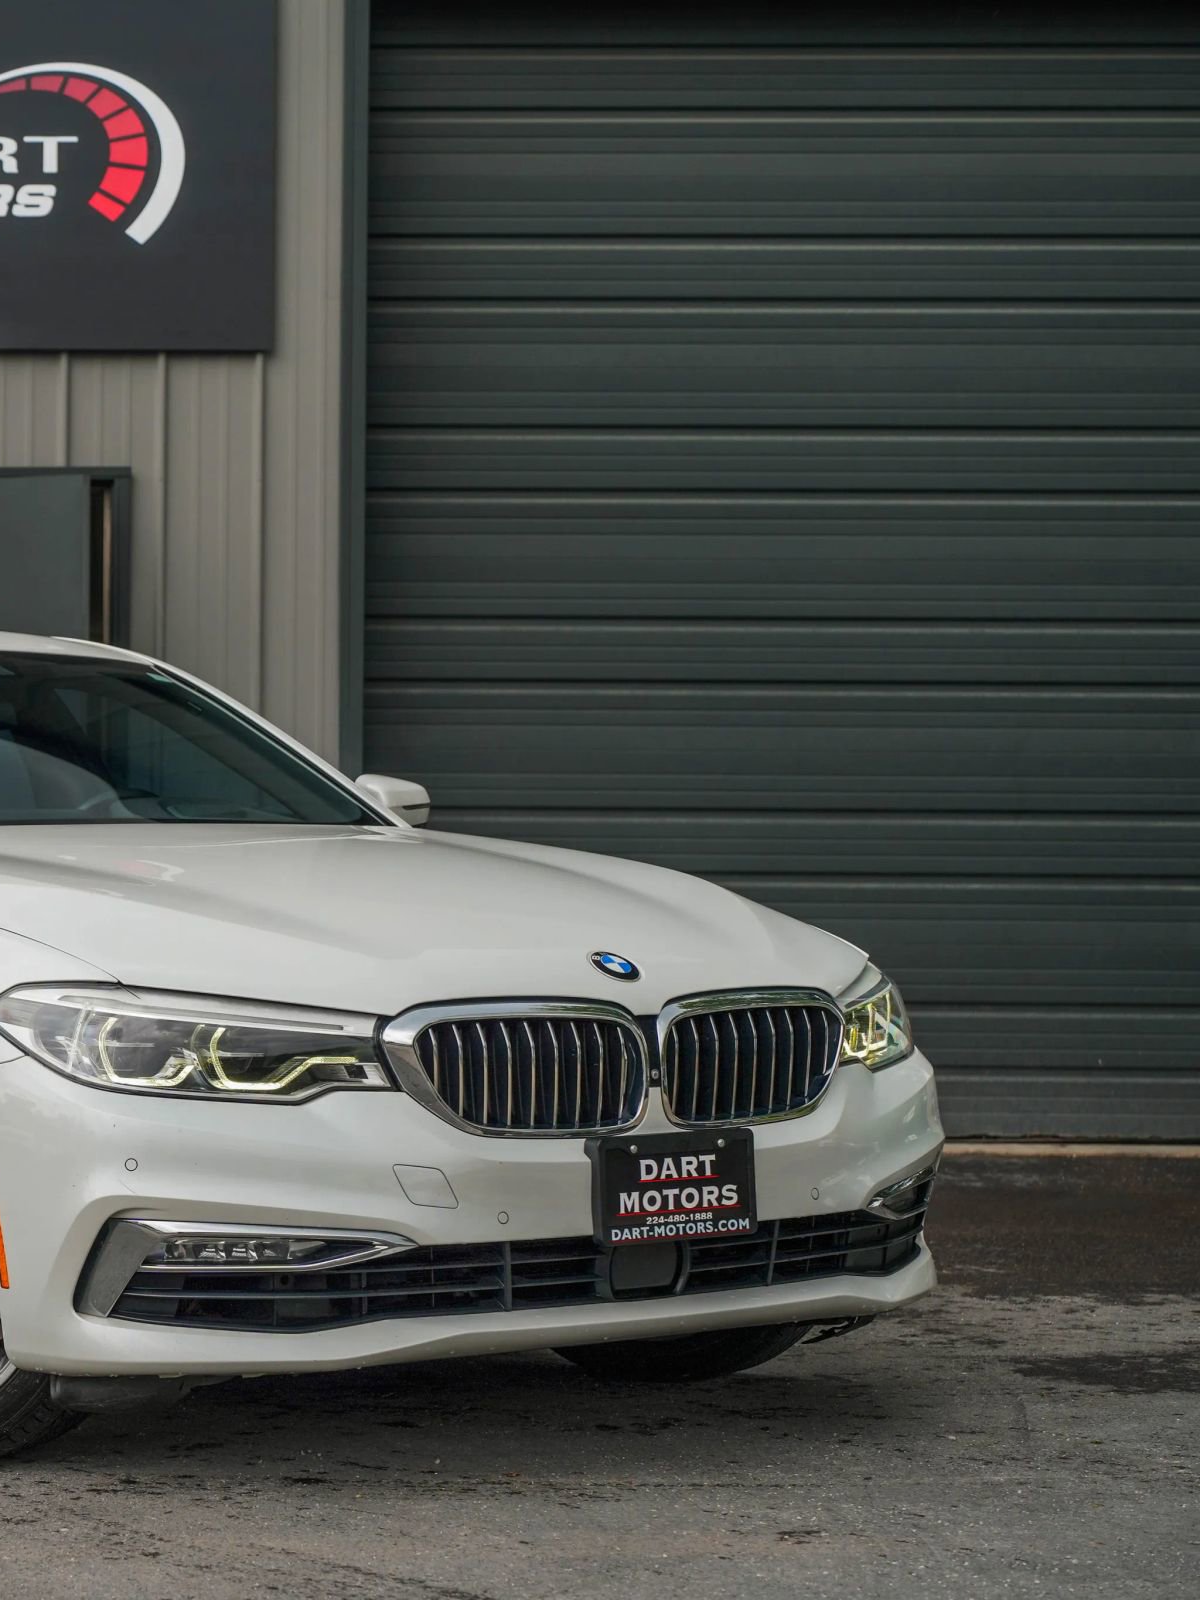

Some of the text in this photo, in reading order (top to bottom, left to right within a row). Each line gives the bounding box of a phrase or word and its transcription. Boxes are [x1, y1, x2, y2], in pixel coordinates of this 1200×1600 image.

[639, 1154, 716, 1181] DART
[619, 1184, 738, 1214] MOTORS
[611, 1217, 750, 1241] DART-MOTORS.COM
[646, 1212, 713, 1225] 224-480-1888
